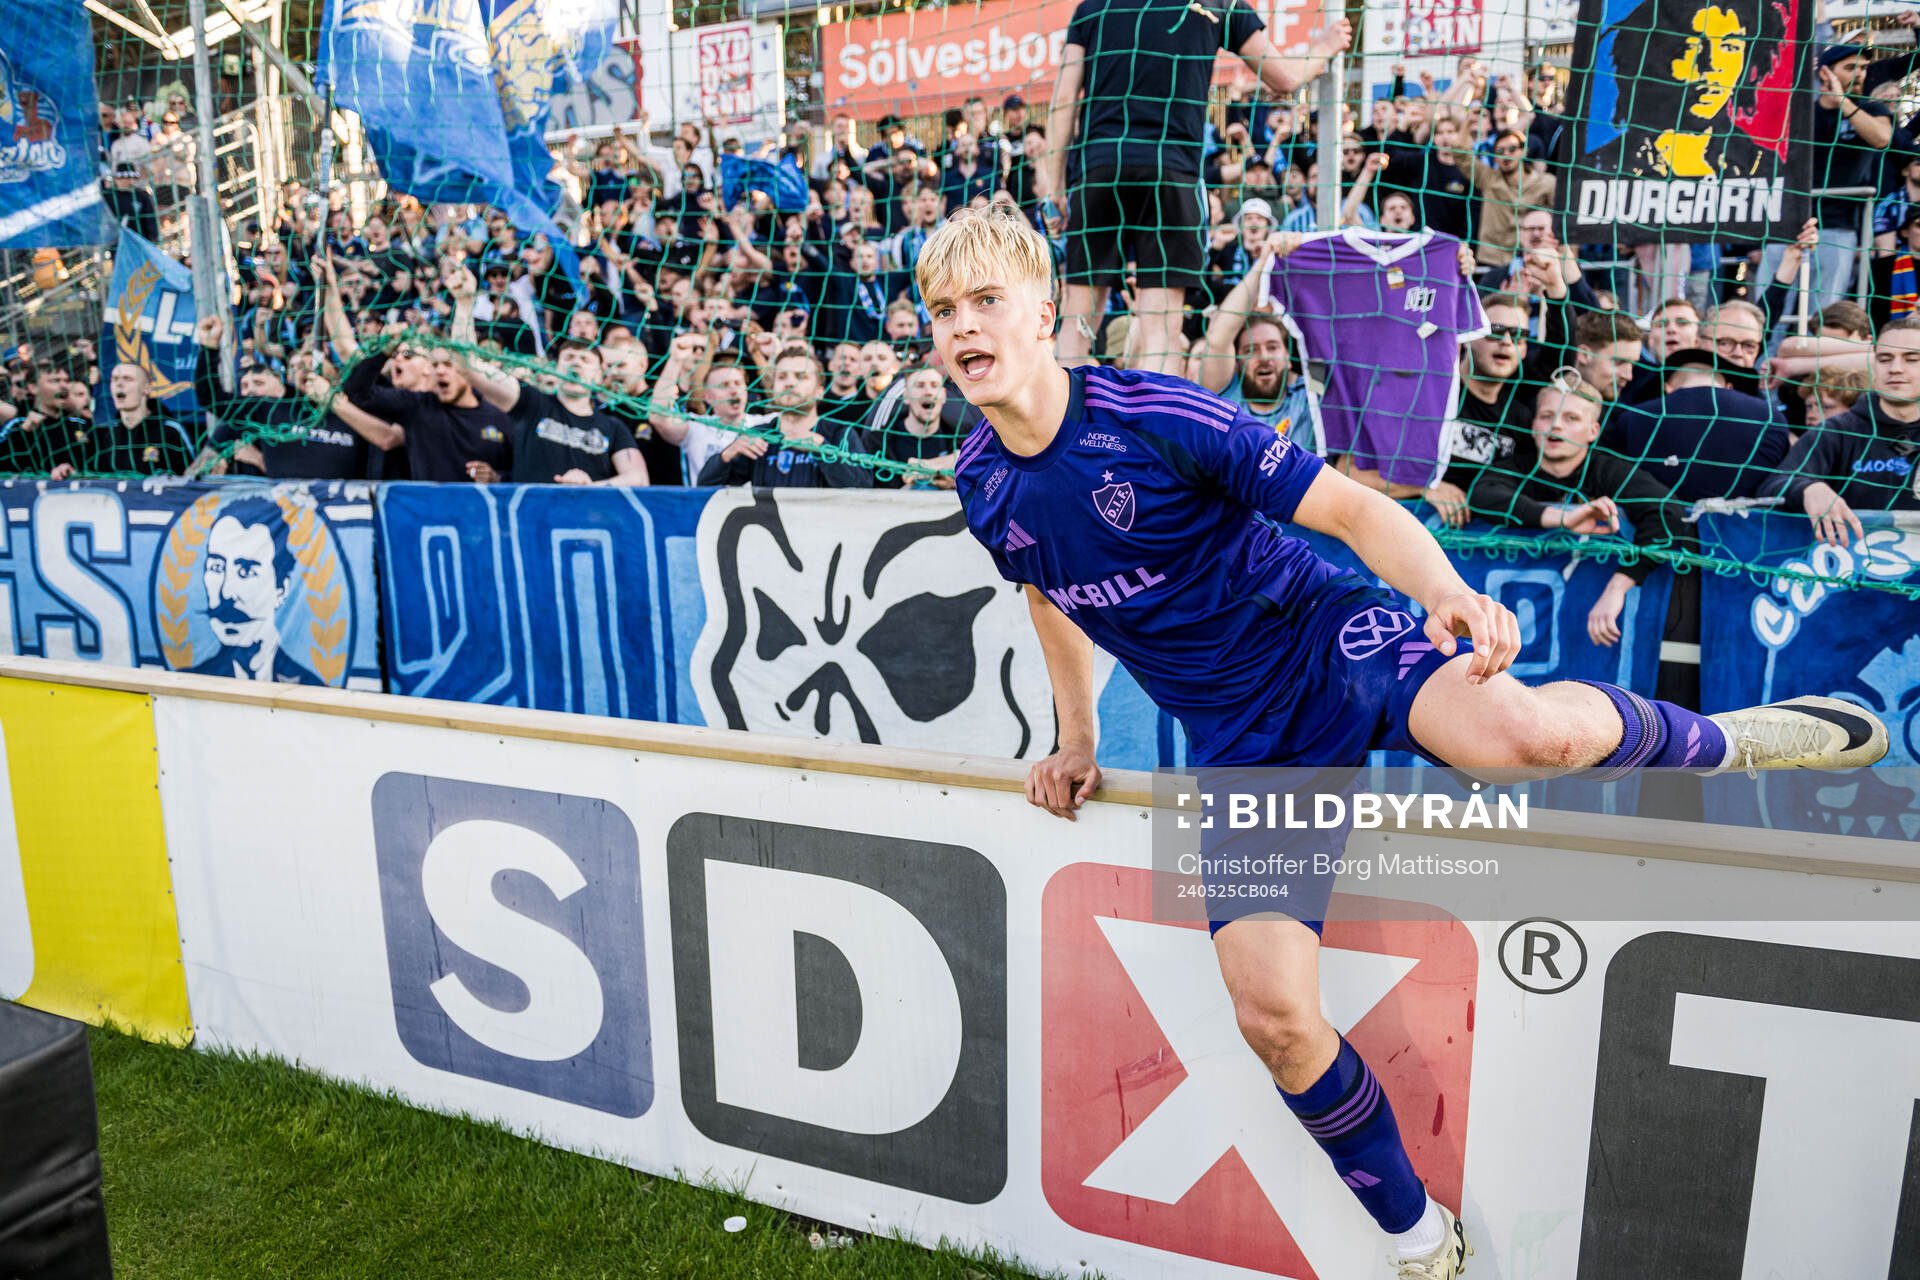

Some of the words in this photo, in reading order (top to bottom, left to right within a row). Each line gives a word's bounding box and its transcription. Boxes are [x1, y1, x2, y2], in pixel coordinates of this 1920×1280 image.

[1079, 438, 1127, 453] WELLNESS
[1087, 432, 1121, 444] NORDIC
[983, 467, 1001, 492] NORDIC
[985, 467, 1009, 502] WELLNESS
[1047, 566, 1167, 614] MCBILL
